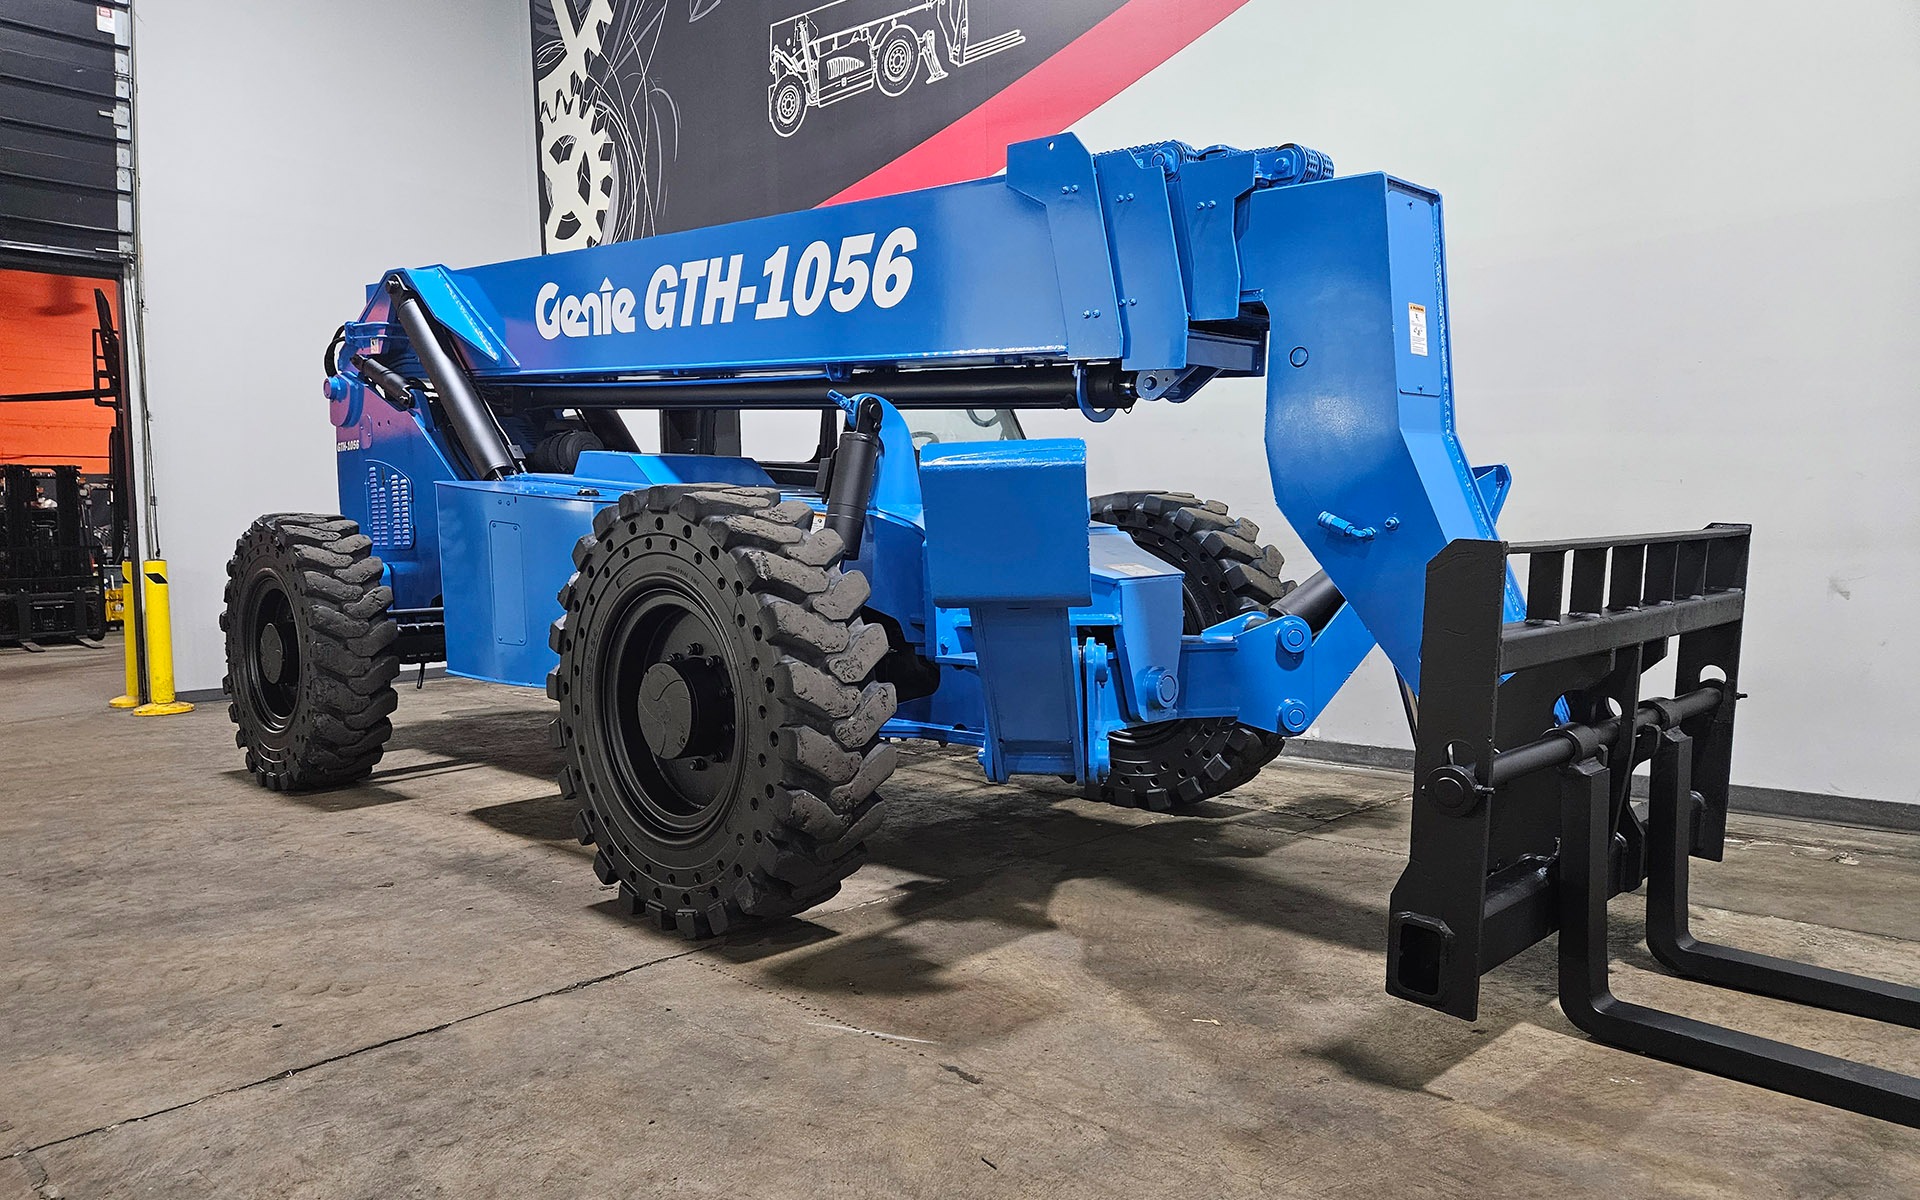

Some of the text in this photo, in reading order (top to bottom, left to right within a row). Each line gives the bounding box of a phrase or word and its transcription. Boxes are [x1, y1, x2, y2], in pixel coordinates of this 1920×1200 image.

[535, 227, 918, 340] Genie GTH-1056
[337, 440, 360, 452] GTH-1056
